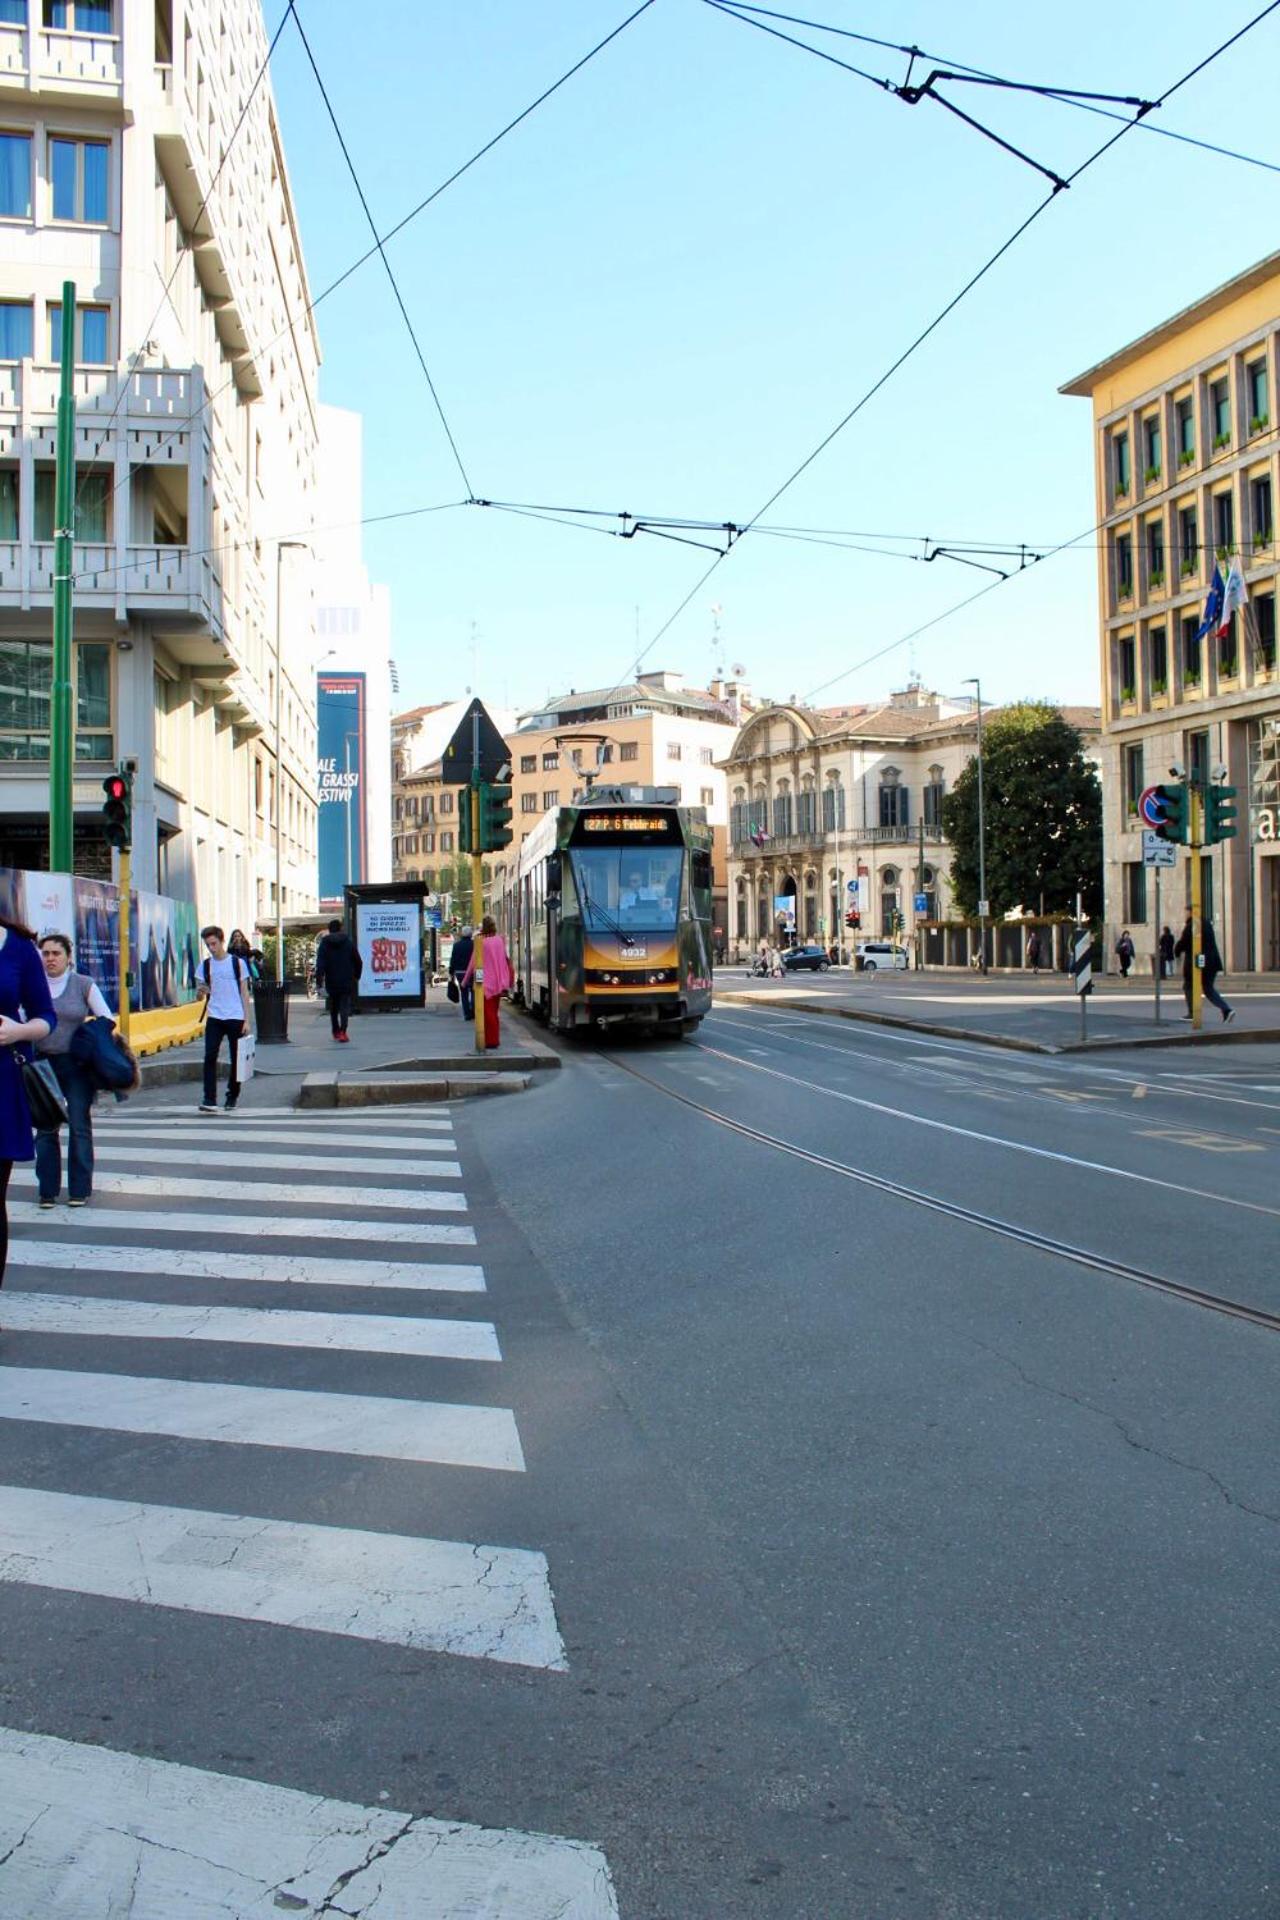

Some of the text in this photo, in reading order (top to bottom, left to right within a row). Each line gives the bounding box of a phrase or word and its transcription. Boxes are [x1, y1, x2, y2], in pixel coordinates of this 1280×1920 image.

[317, 758, 337, 772] ALE
[322, 773, 359, 787] GRASSI
[319, 787, 353, 802] ESTIVO
[588, 818, 602, 831] 27
[1258, 808, 1280, 840] a
[371, 938, 407, 957] SOTTO
[371, 956, 407, 973] COSTO
